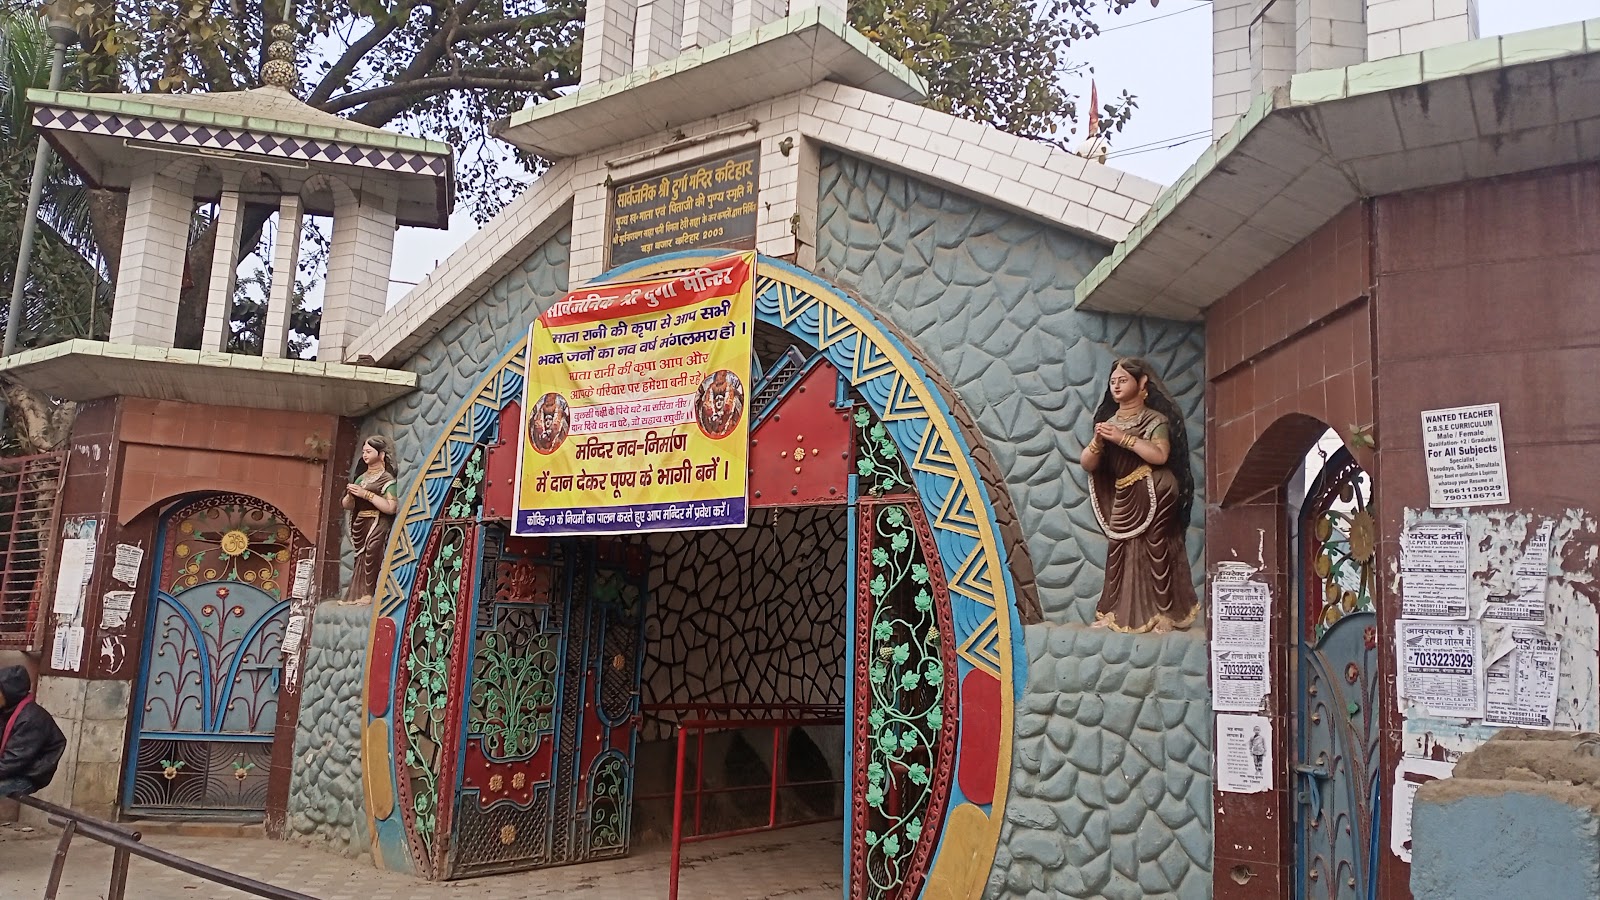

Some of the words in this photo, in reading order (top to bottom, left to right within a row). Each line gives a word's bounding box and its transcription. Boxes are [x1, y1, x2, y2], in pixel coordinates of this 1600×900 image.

[617, 183, 657, 208] सार्वजनिक
[658, 176, 671, 198] श्री
[672, 173, 688, 200] दुर्गा
[689, 168, 714, 190] मन्दिर
[714, 159, 754, 184] कटिहार
[668, 196, 694, 215] पिताजी
[695, 192, 706, 208] की
[707, 190, 724, 209] पुण्य
[726, 184, 745, 202] स्मृति
[675, 232, 700, 246] कटिहार
[702, 227, 724, 240] 2003
[546, 293, 620, 318] सार्वजनिक
[620, 289, 643, 307] श्री
[552, 330, 580, 344] माता
[582, 324, 608, 341] रानी
[610, 321, 628, 338] की
[631, 320, 656, 340] कृपा
[660, 314, 672, 330] से
[673, 310, 697, 326] आप
[700, 300, 731, 320] सभी
[538, 353, 564, 366] भक्त
[566, 344, 596, 362] जनों
[598, 345, 615, 358] का
[618, 342, 636, 356] नव
[639, 336, 657, 353] वर्ष
[659, 328, 718, 350] मंगलमय
[719, 321, 736, 340] हो
[594, 364, 616, 378] रानी
[617, 360, 633, 376] की
[634, 360, 657, 378] कृपा
[659, 356, 684, 369] आप
[570, 385, 594, 400] आपके
[596, 380, 626, 397] परिवार
[628, 381, 641, 393] पर
[642, 375, 669, 393] हमेशा
[670, 372, 688, 388] बनी
[608, 406, 615, 416] के
[642, 404, 651, 412] ना
[675, 398, 688, 408] नीर
[571, 422, 583, 432] दान
[642, 415, 662, 426] सहाय
[664, 411, 685, 425] रघुवीर
[1426, 413, 1456, 424] WANTED
[1458, 410, 1494, 420] TEACHER
[1427, 424, 1449, 432] C.B.S.E
[1450, 420, 1493, 430] CURRICULUM
[1436, 432, 1454, 440] Male
[1458, 430, 1484, 438] Female
[1470, 436, 1496, 444] Graduate
[576, 436, 614, 460] मन्दिर
[616, 428, 688, 458] नव-निर्माण
[1428, 449, 1442, 458] For
[1444, 447, 1456, 456] All
[1458, 444, 1498, 456] Subjects
[1476, 461, 1500, 469] Simultala
[535, 470, 549, 492] में
[550, 474, 573, 492] दान
[576, 468, 608, 491] देकर
[610, 474, 636, 498] पूण्य
[640, 464, 652, 486] के
[657, 458, 692, 484] भागी
[695, 456, 720, 482] बनें
[1442, 484, 1502, 494] 9661139029
[1444, 492, 1503, 501] 7903186714
[556, 512, 564, 524] के
[564, 510, 586, 524] नियमों
[586, 513, 596, 524] का
[596, 513, 616, 524] पालन
[616, 508, 634, 522] करते
[634, 511, 645, 528] हुए
[646, 510, 662, 522] आप
[662, 506, 685, 520] मन्दिर
[686, 504, 694, 518] में
[694, 502, 712, 520] प्रवेश
[1441, 532, 1463, 540] भर्ती
[1224, 606, 1264, 616] 7033223929
[1406, 628, 1453, 636] आवश्यकता
[1458, 627, 1464, 636] है
[1444, 636, 1464, 646] शोरूम
[1414, 652, 1473, 668] 7033223929
[1224, 664, 1264, 675] 7033223929
